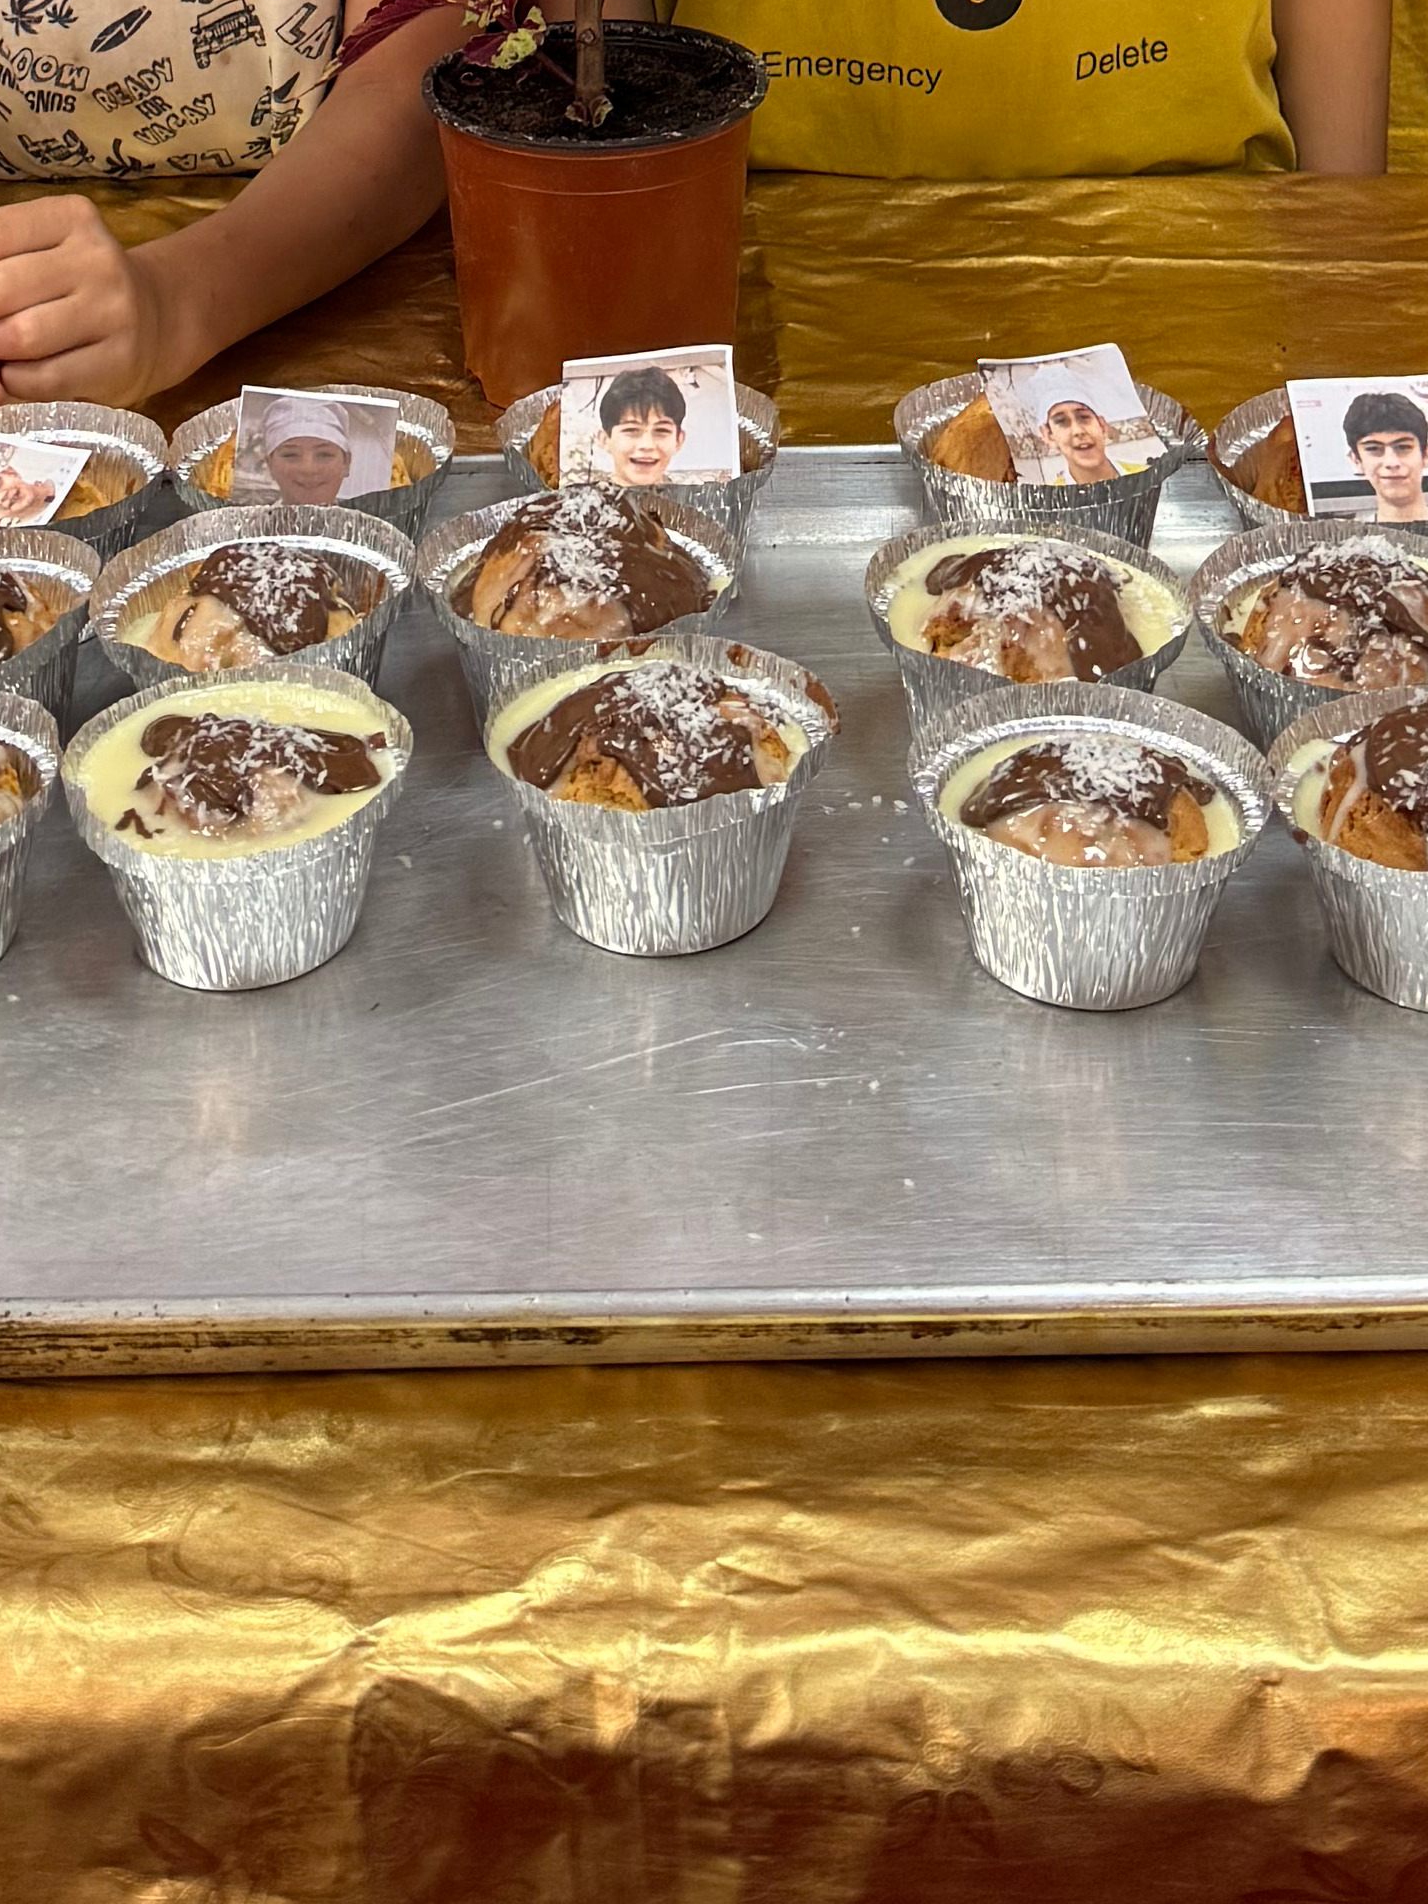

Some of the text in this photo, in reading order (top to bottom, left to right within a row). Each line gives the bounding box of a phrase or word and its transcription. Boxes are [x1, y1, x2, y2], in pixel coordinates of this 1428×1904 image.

[276, 2, 336, 59] LA
[92, 57, 174, 113] READY
[762, 37, 1169, 94] Emergency Delete
[134, 93, 216, 145] VACAY
[135, 96, 172, 120] FOR
